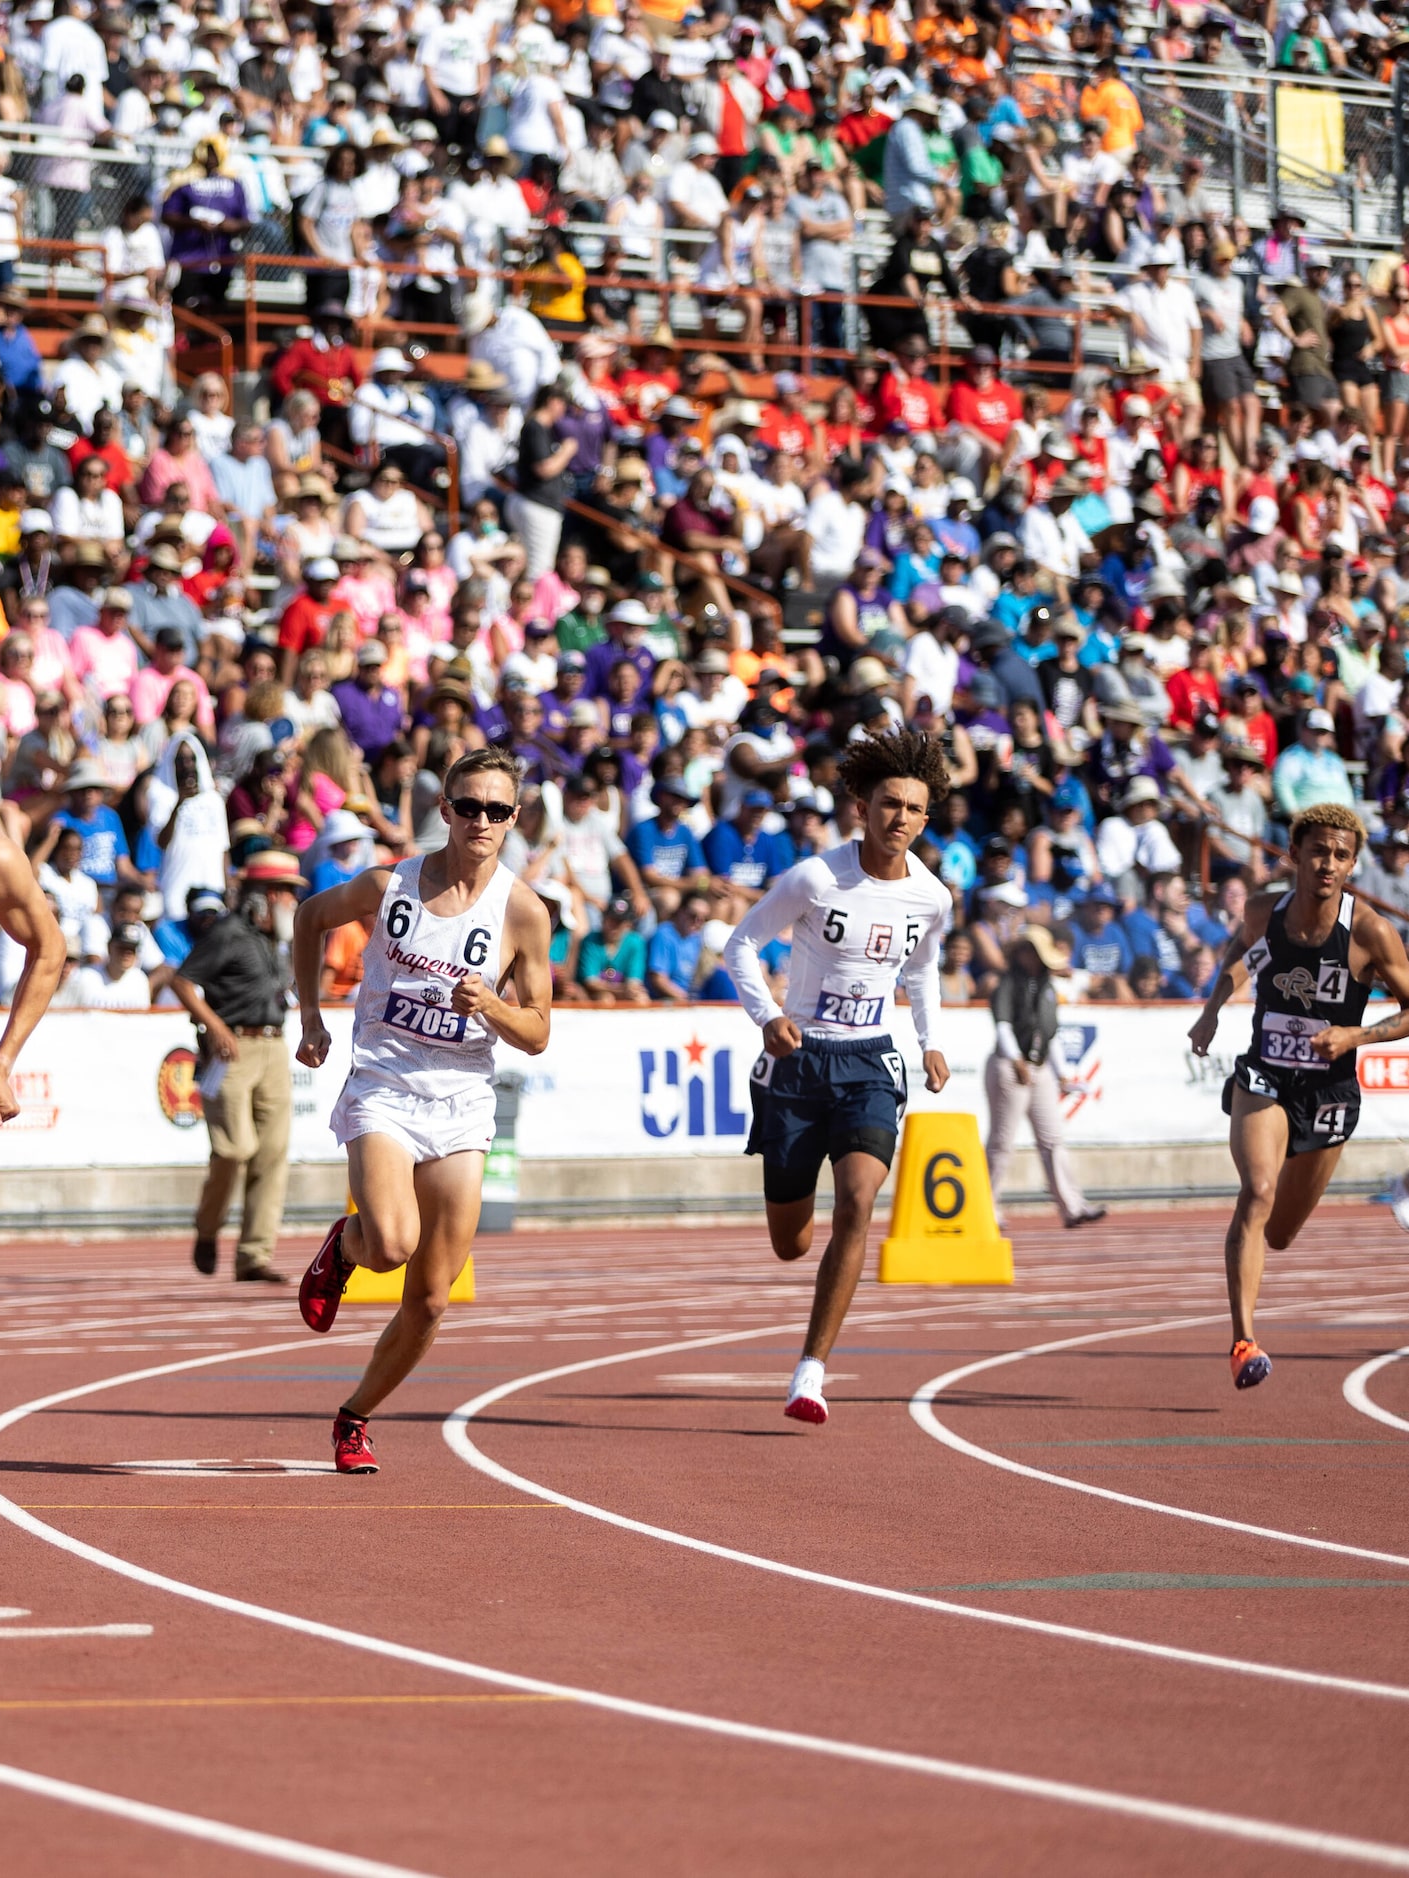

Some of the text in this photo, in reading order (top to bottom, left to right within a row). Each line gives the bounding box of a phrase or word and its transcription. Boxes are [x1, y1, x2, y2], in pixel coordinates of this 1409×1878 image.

[386, 899, 492, 966] 6 6
[822, 908, 920, 957] 5 5
[1246, 947, 1341, 1000] 4 4
[391, 999, 460, 1039] 2705
[826, 996, 880, 1027] 2887
[639, 1049, 746, 1138] UIL
[1318, 1105, 1339, 1131] 4
[923, 1152, 966, 1220] 6
